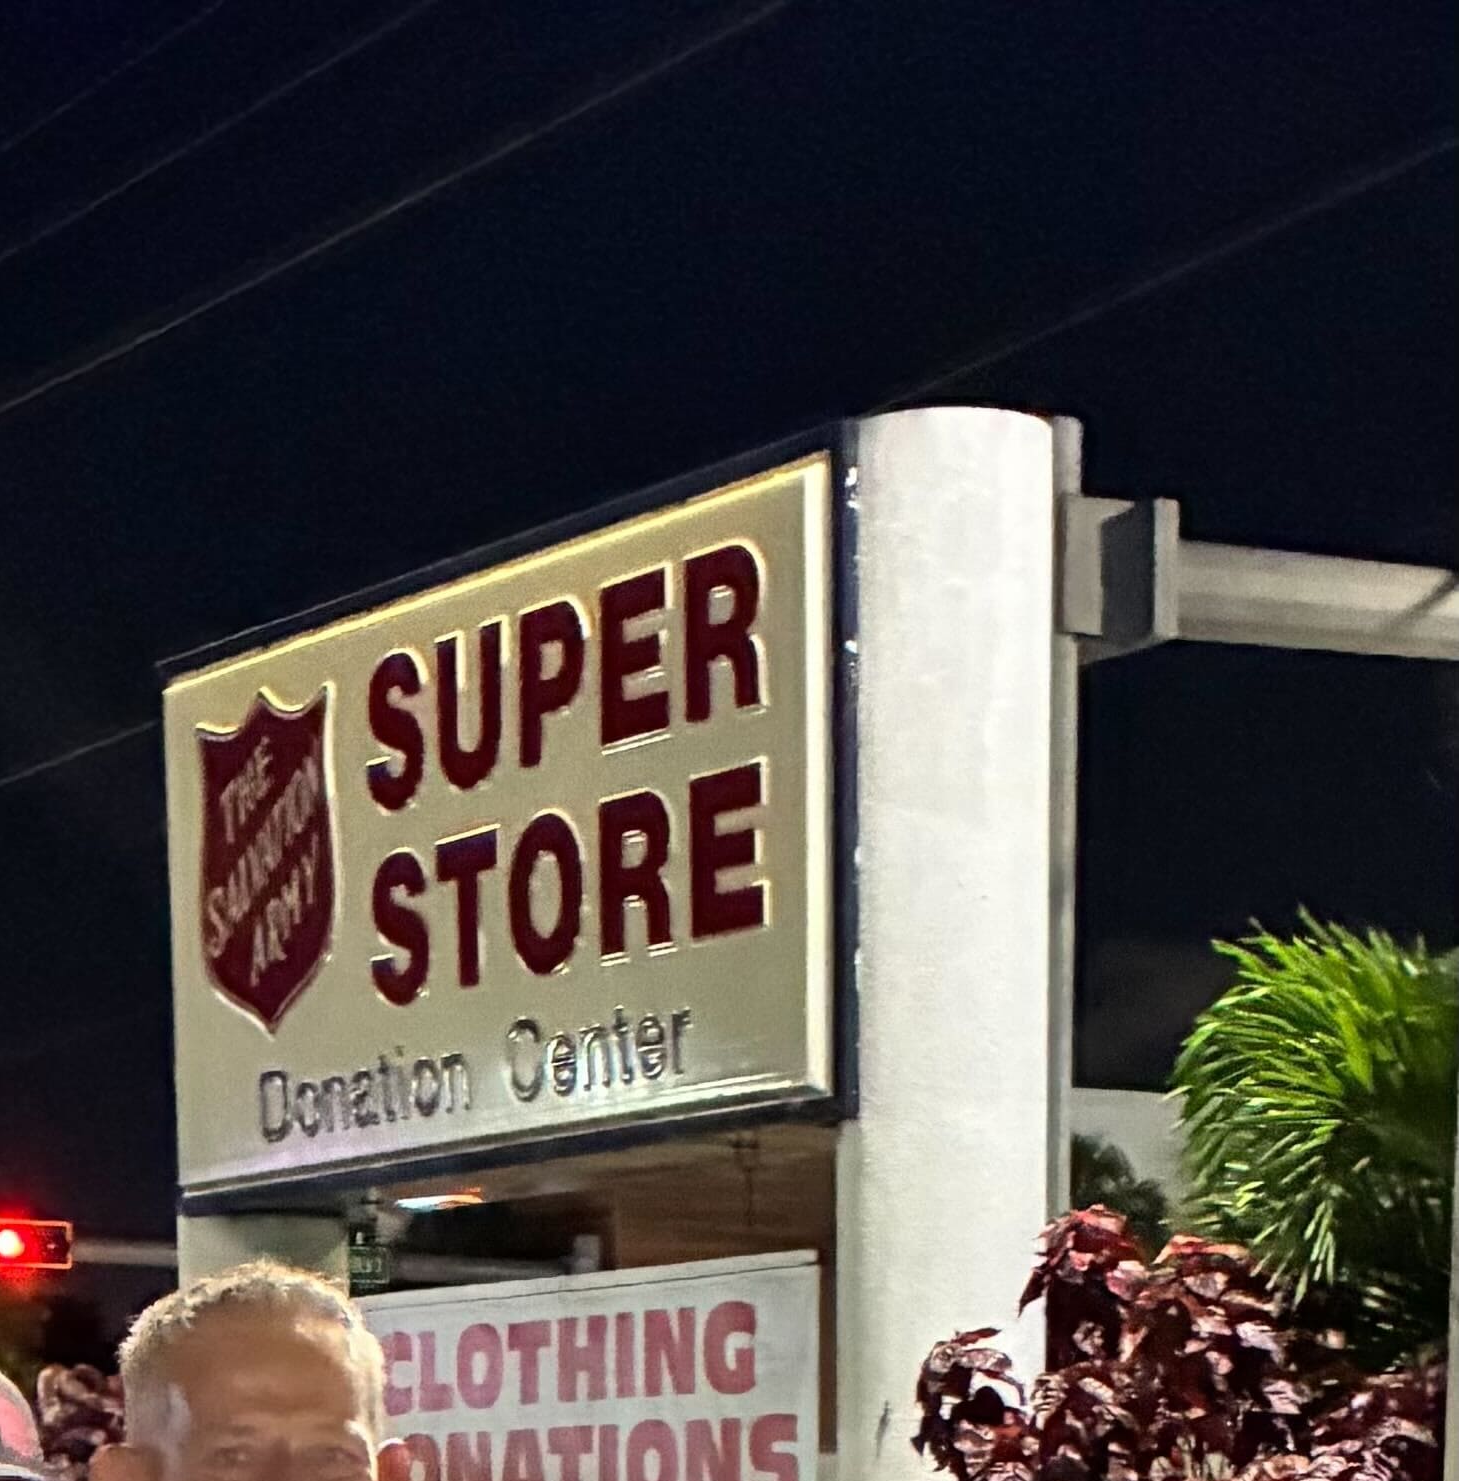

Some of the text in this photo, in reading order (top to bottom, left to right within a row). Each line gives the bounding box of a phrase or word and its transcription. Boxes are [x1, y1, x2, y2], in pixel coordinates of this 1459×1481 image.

[366, 545, 766, 812] SUPER
[370, 758, 767, 1006] STORE
[259, 1006, 692, 1144] Donation Center
[383, 1300, 757, 1416] CLOTHING
